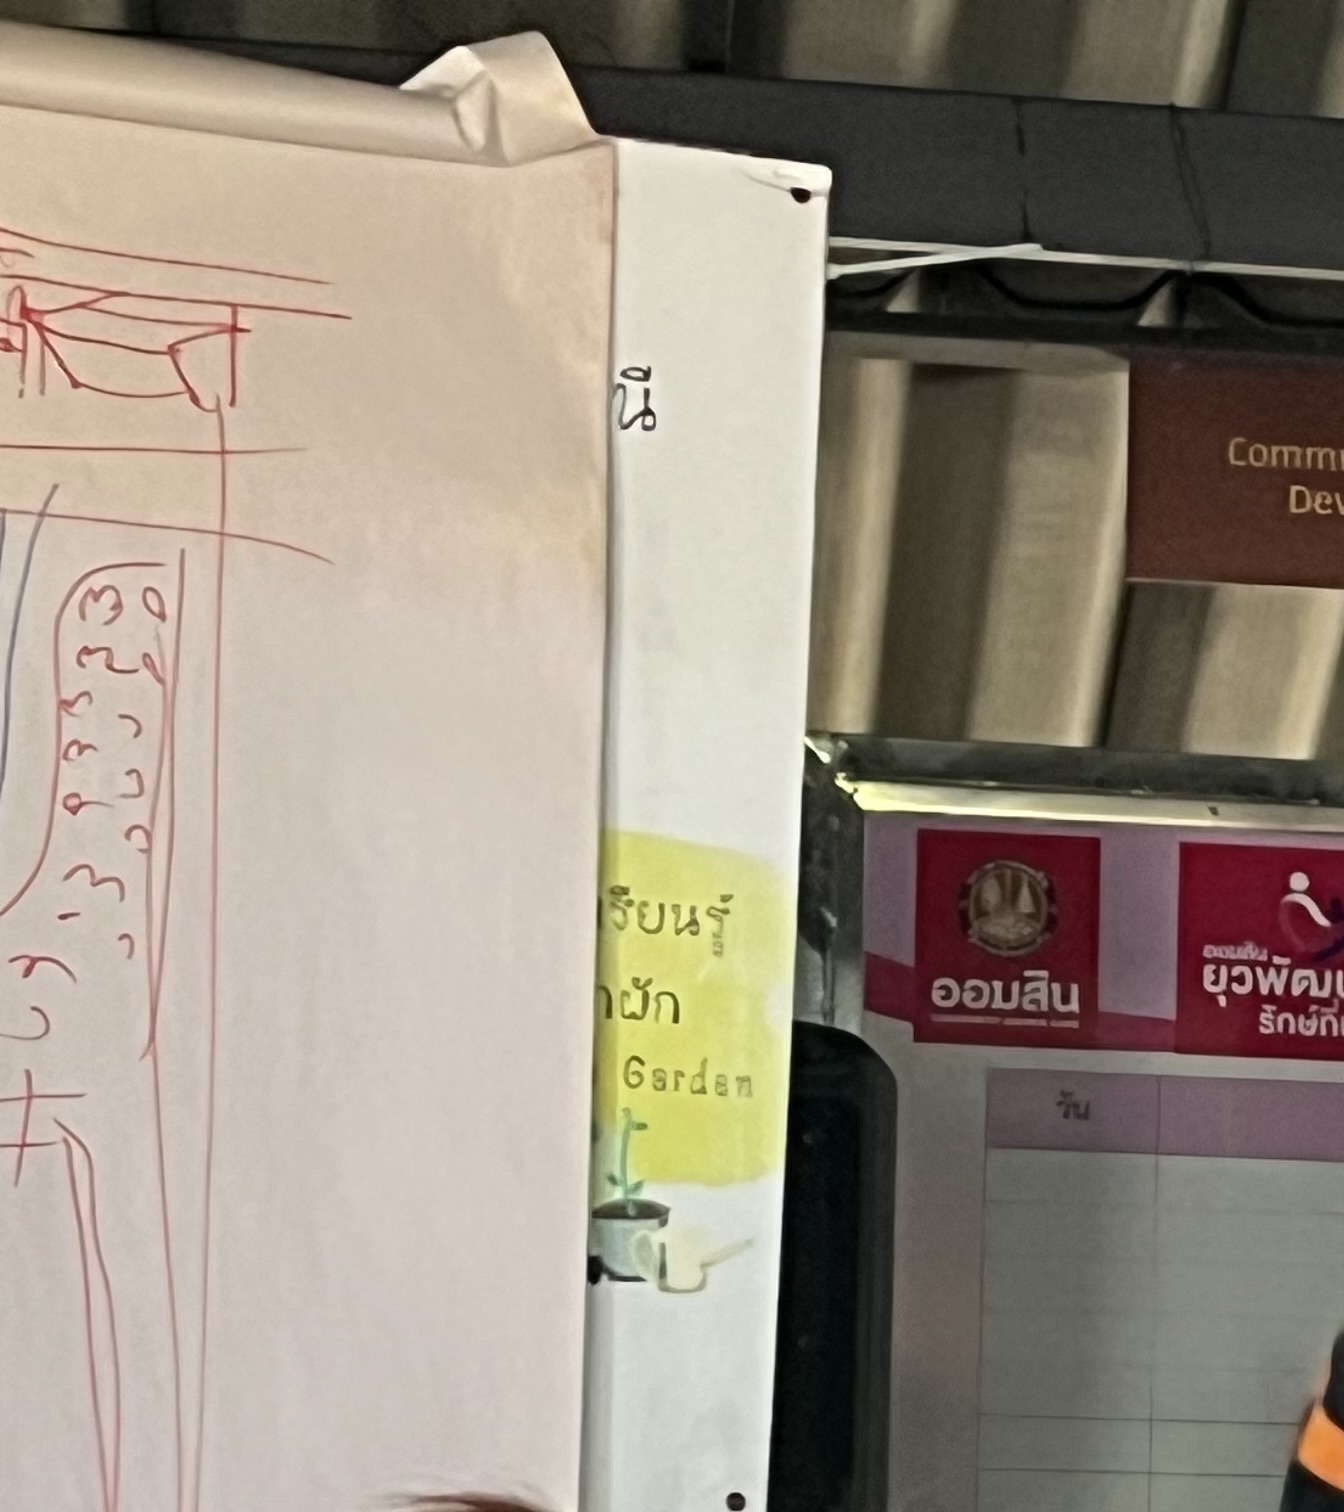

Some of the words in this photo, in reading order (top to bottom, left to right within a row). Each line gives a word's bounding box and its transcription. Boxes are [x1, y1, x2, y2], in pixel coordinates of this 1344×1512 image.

[931, 970, 1080, 1015] ออมสิน
[623, 1055, 753, 1098] Garden
